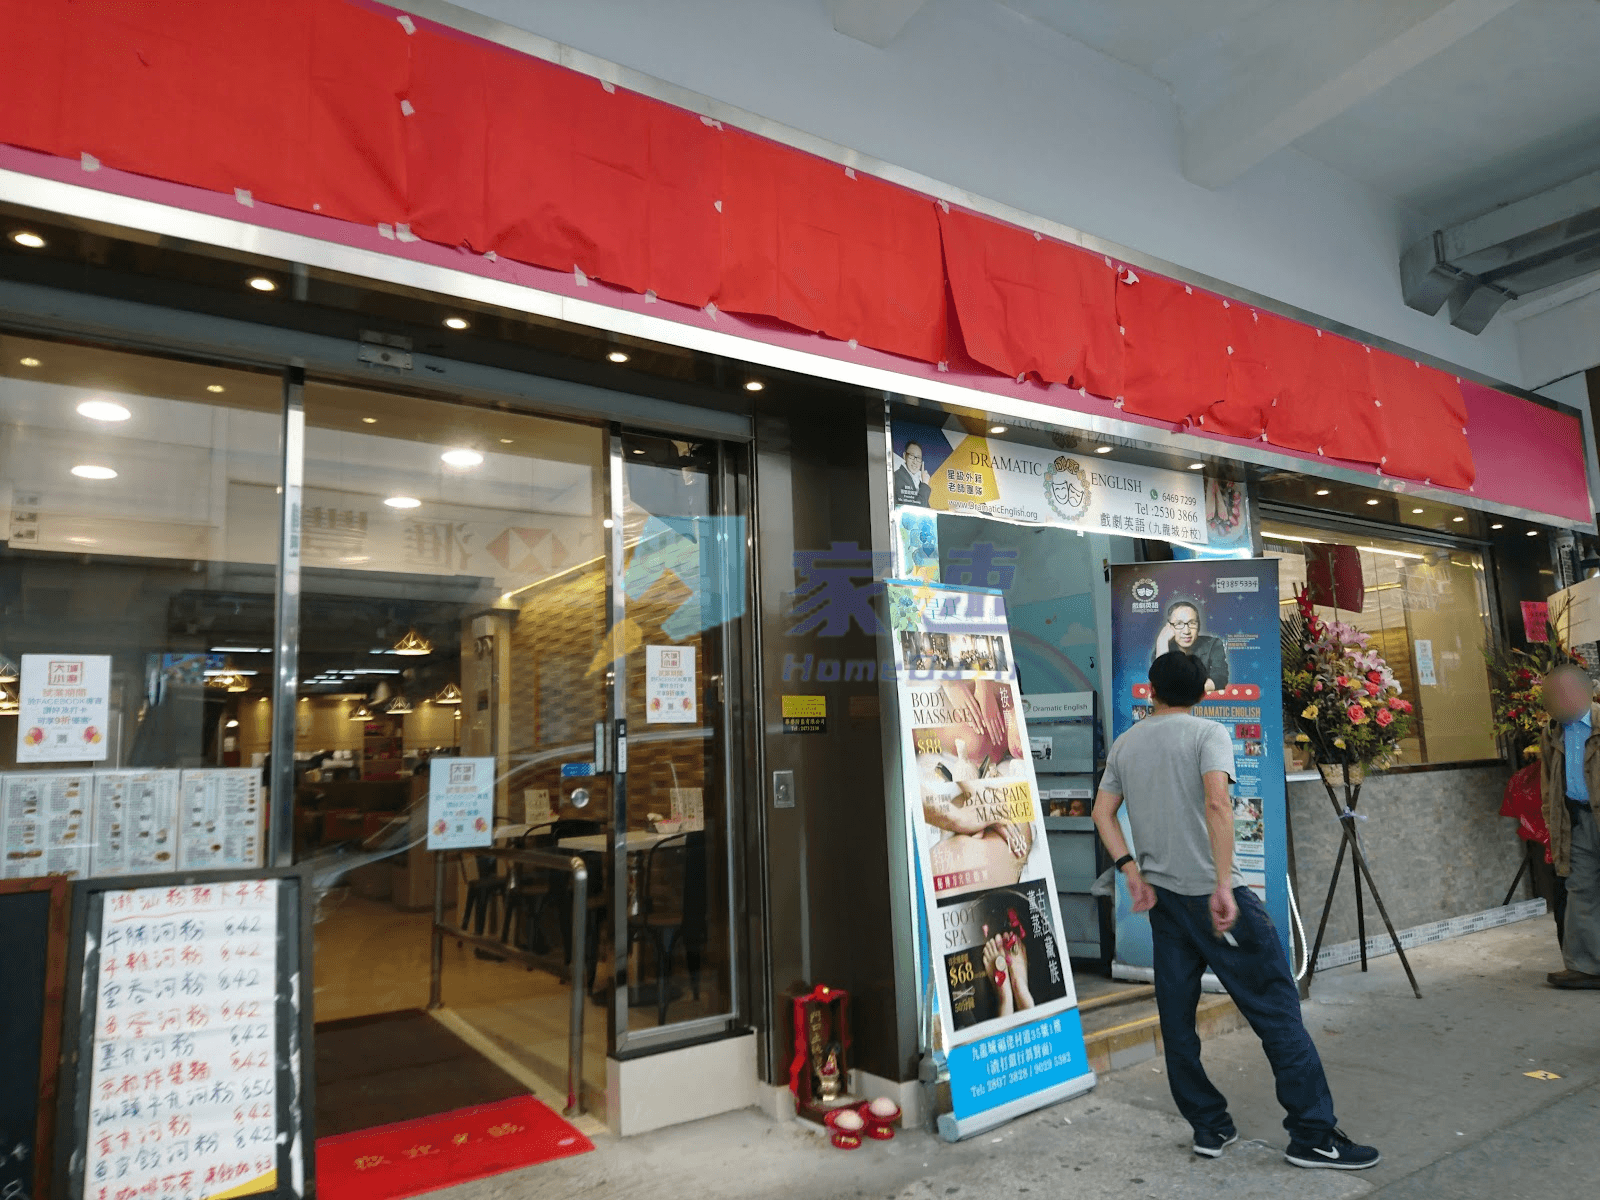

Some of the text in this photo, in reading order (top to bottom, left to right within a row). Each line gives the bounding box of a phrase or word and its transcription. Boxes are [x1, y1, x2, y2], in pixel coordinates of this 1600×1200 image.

[970, 451, 1142, 493] DRAMATIC ENGLISH
[1162, 492, 1197, 506] 6469 7299
[948, 500, 1038, 520] www.DramaticEnglish.org
[1177, 509, 1198, 523] 3866
[911, 692, 946, 709] BODY
[1063, 703, 1088, 711] English
[913, 708, 973, 724] MASSAGE
[1193, 705, 1261, 718] DRAMATIC ENGLISH
[917, 738, 942, 755] $88
[964, 786, 1000, 807] BACK
[1002, 785, 1029, 803] PAIN
[976, 801, 1032, 823] MASSAGE
[941, 906, 976, 930] FOOT
[944, 928, 969, 949] SPA
[949, 961, 974, 988] $68
